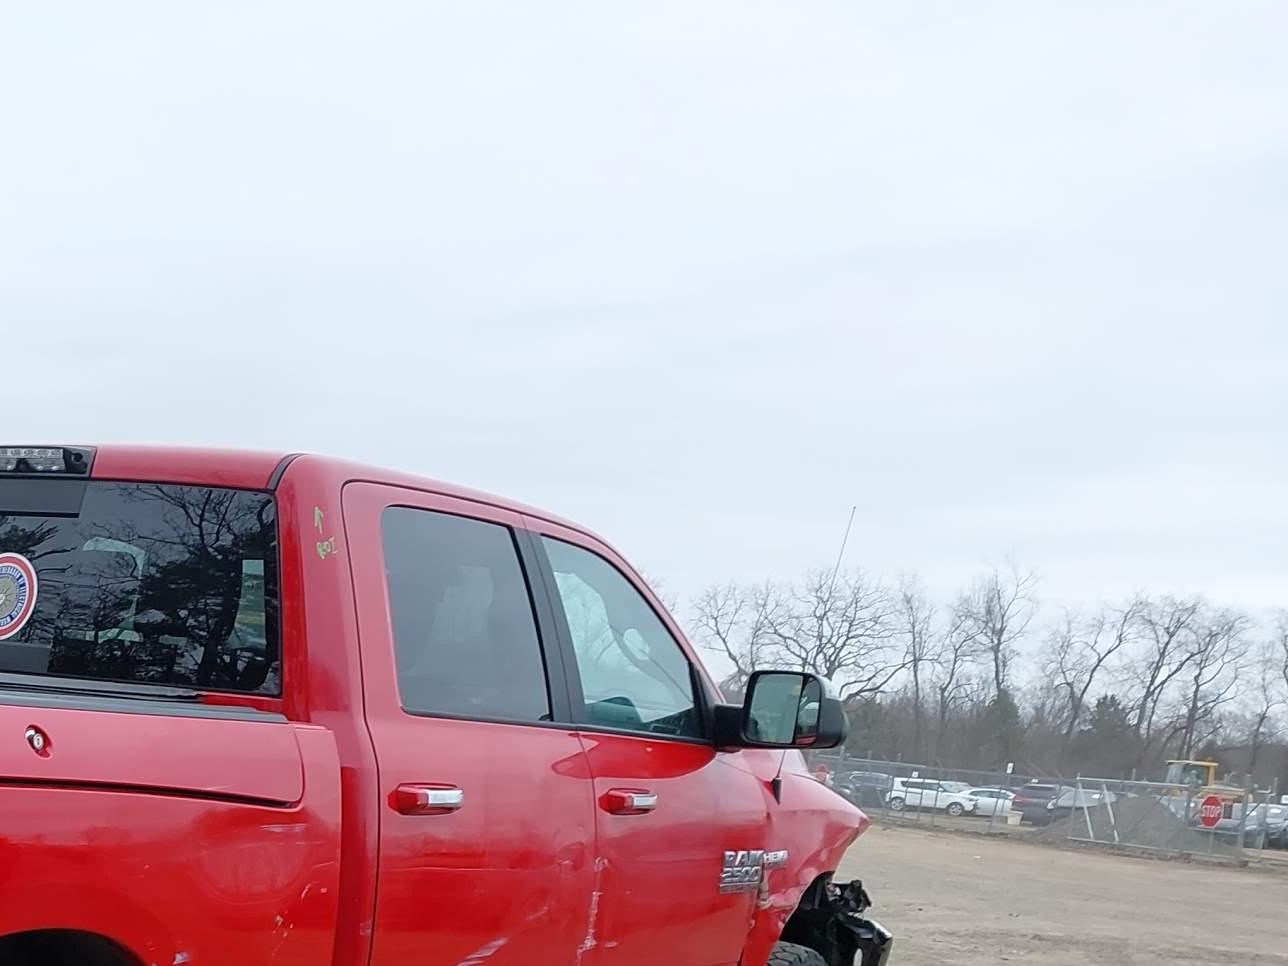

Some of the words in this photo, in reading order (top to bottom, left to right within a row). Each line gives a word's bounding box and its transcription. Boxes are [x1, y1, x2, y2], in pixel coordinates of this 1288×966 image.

[1201, 805, 1220, 818] STOP
[724, 850, 764, 866] RAM
[720, 866, 761, 882] 2500
